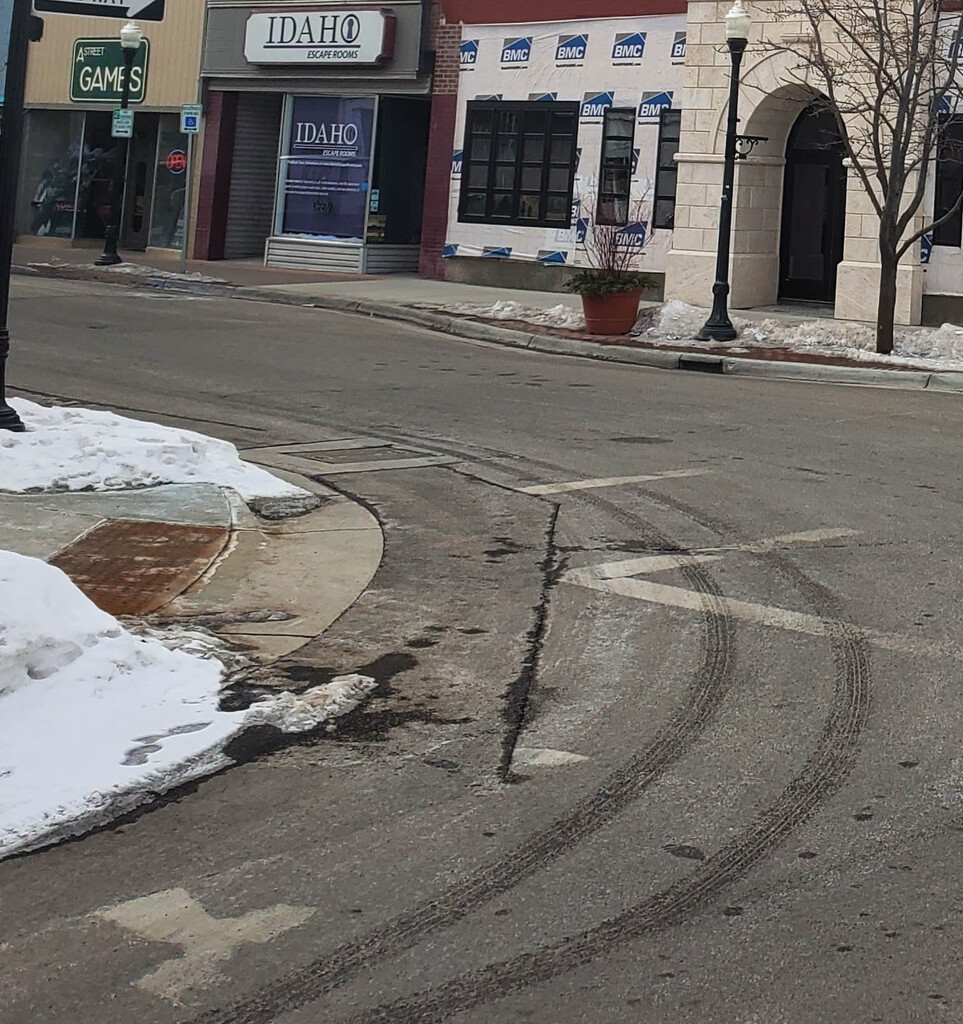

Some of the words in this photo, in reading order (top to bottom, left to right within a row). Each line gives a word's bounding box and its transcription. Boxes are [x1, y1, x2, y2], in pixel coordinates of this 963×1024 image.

[265, 13, 360, 44] IDAHO
[84, 46, 105, 56] STREET
[307, 50, 332, 59] ESCAPE
[333, 50, 359, 59] ROOMS
[460, 51, 475, 63] MC
[503, 49, 528, 61] BMC
[557, 46, 584, 59] BMC
[614, 44, 642, 57] BMC
[80, 66, 142, 93] GAMES
[295, 122, 358, 145] IDAHO
